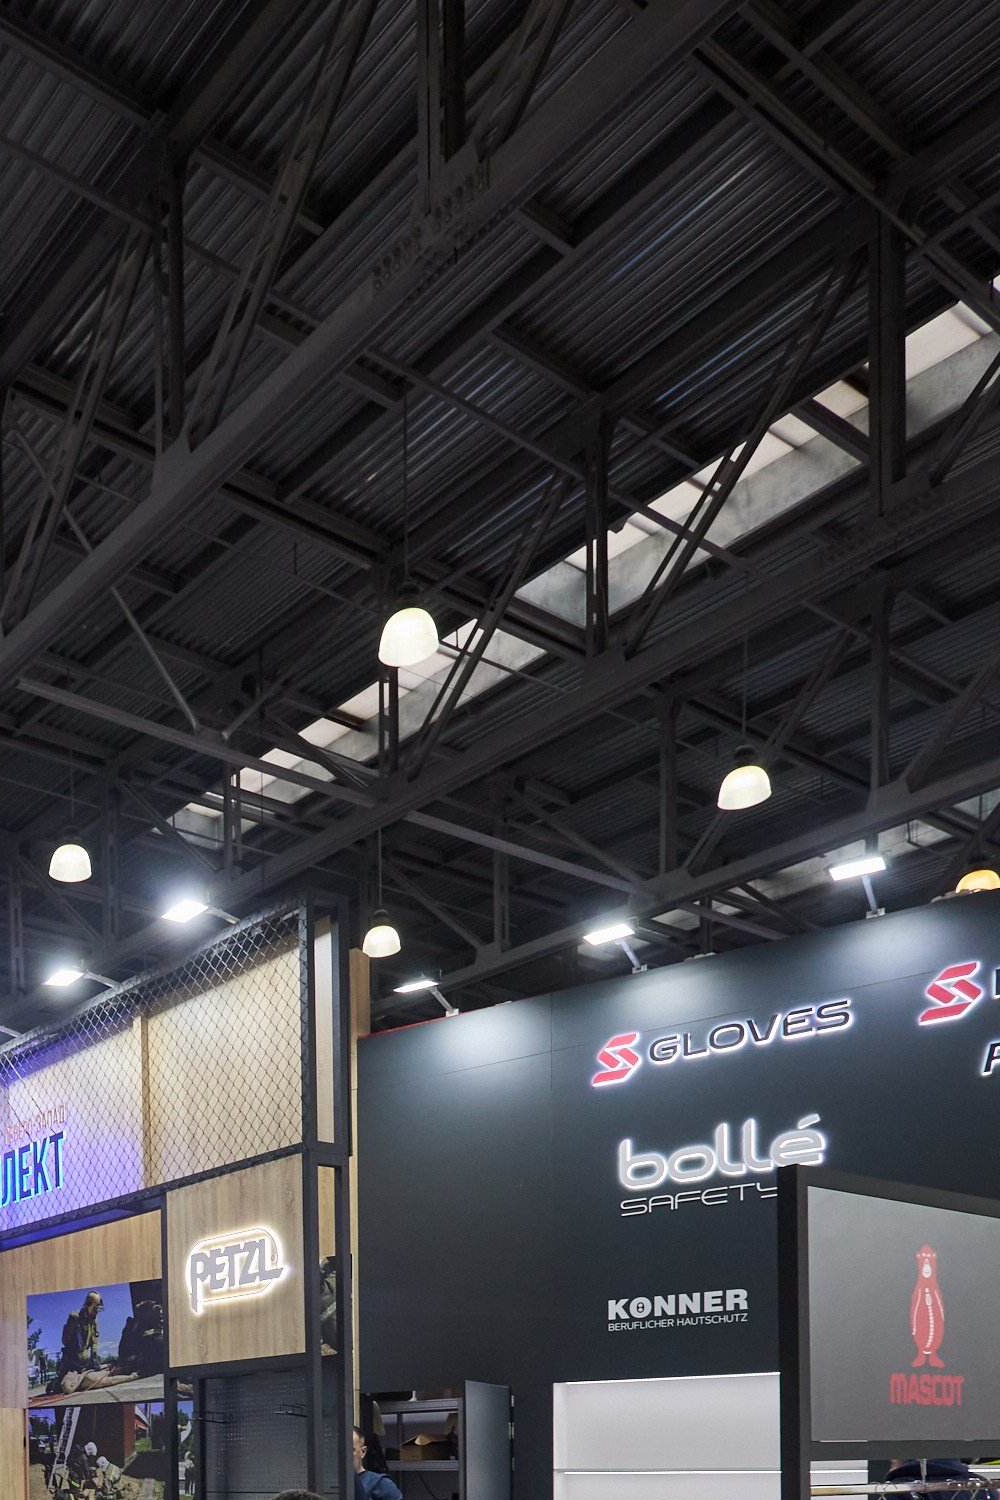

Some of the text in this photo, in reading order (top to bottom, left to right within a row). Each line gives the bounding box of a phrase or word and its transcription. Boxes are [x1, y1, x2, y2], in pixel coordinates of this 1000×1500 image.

[649, 999, 853, 1066] GLOVES
[618, 1113, 826, 1190] bollé
[190, 1238, 284, 1313] PETZL
[608, 1312, 748, 1332] BERUFLICHER HAUTSCHUTZ
[889, 1373, 965, 1406] MASCOT
